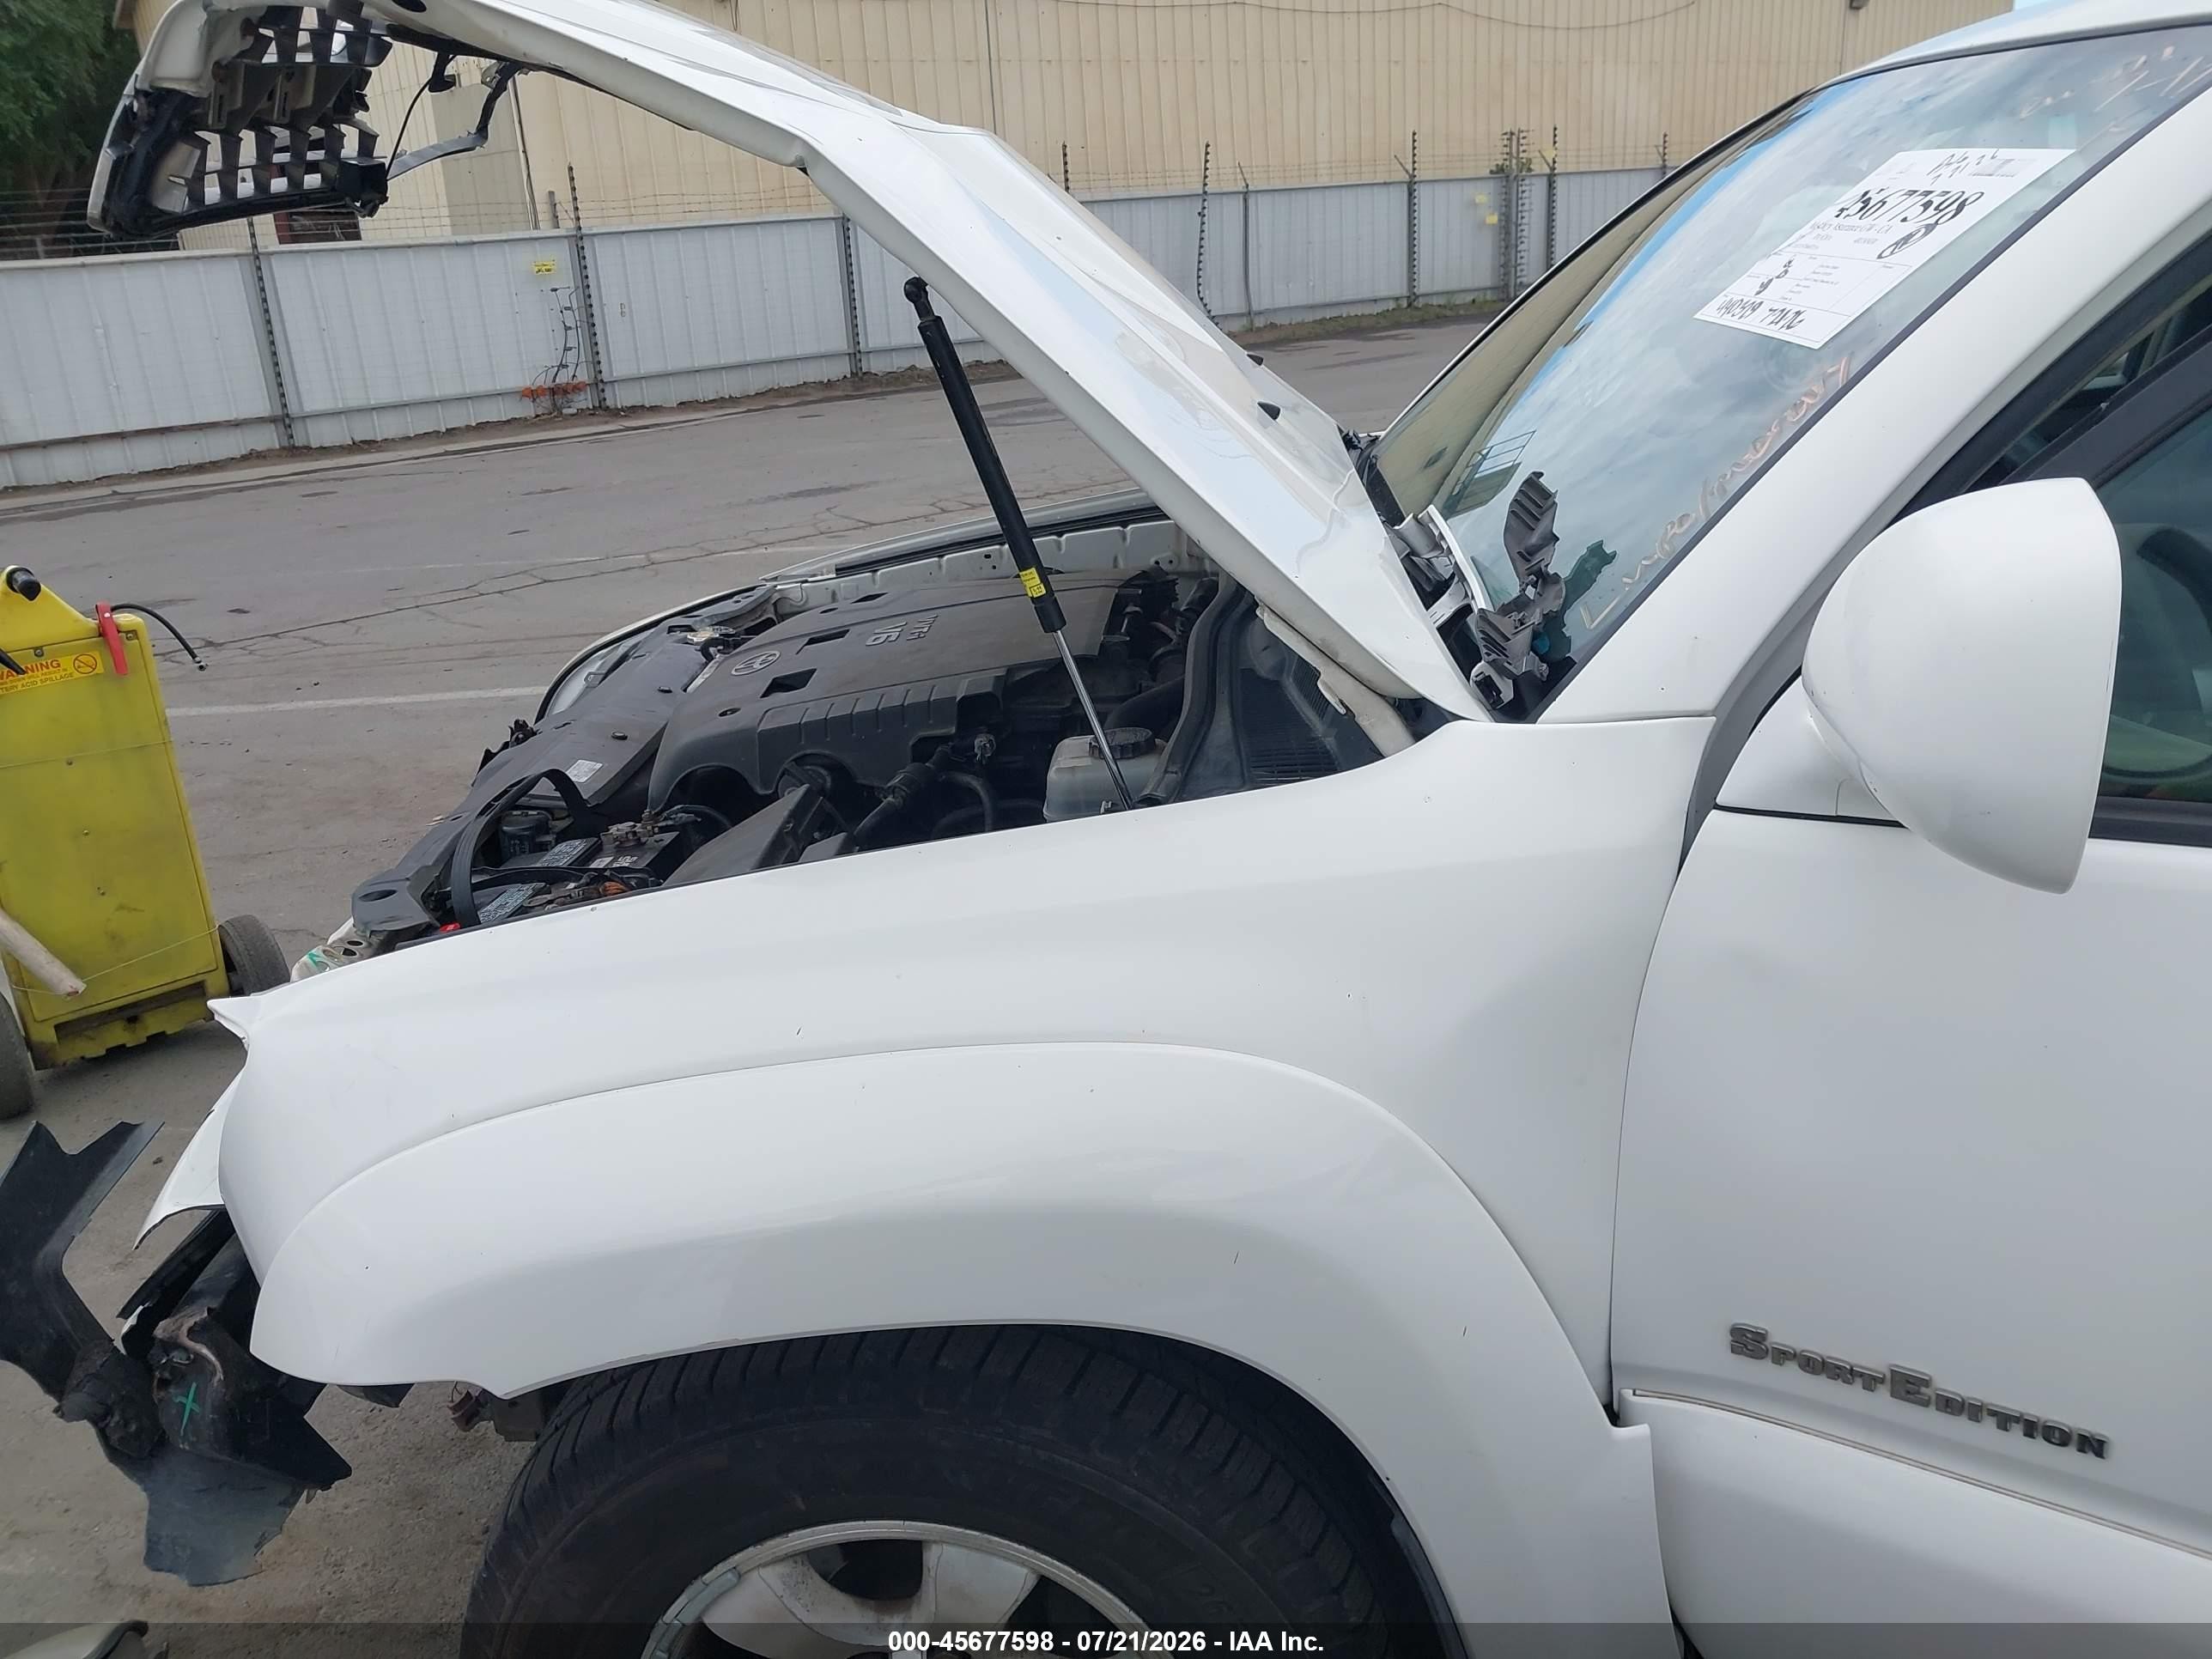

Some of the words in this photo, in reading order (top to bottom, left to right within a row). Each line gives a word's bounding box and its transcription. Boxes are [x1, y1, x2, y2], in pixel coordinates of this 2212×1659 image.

[1834, 186, 1984, 225] 45677598
[866, 621, 907, 647] V6
[0, 659, 61, 681] ANING
[21, 679, 39, 689] ACID
[40, 672, 74, 684] SPILLAGE
